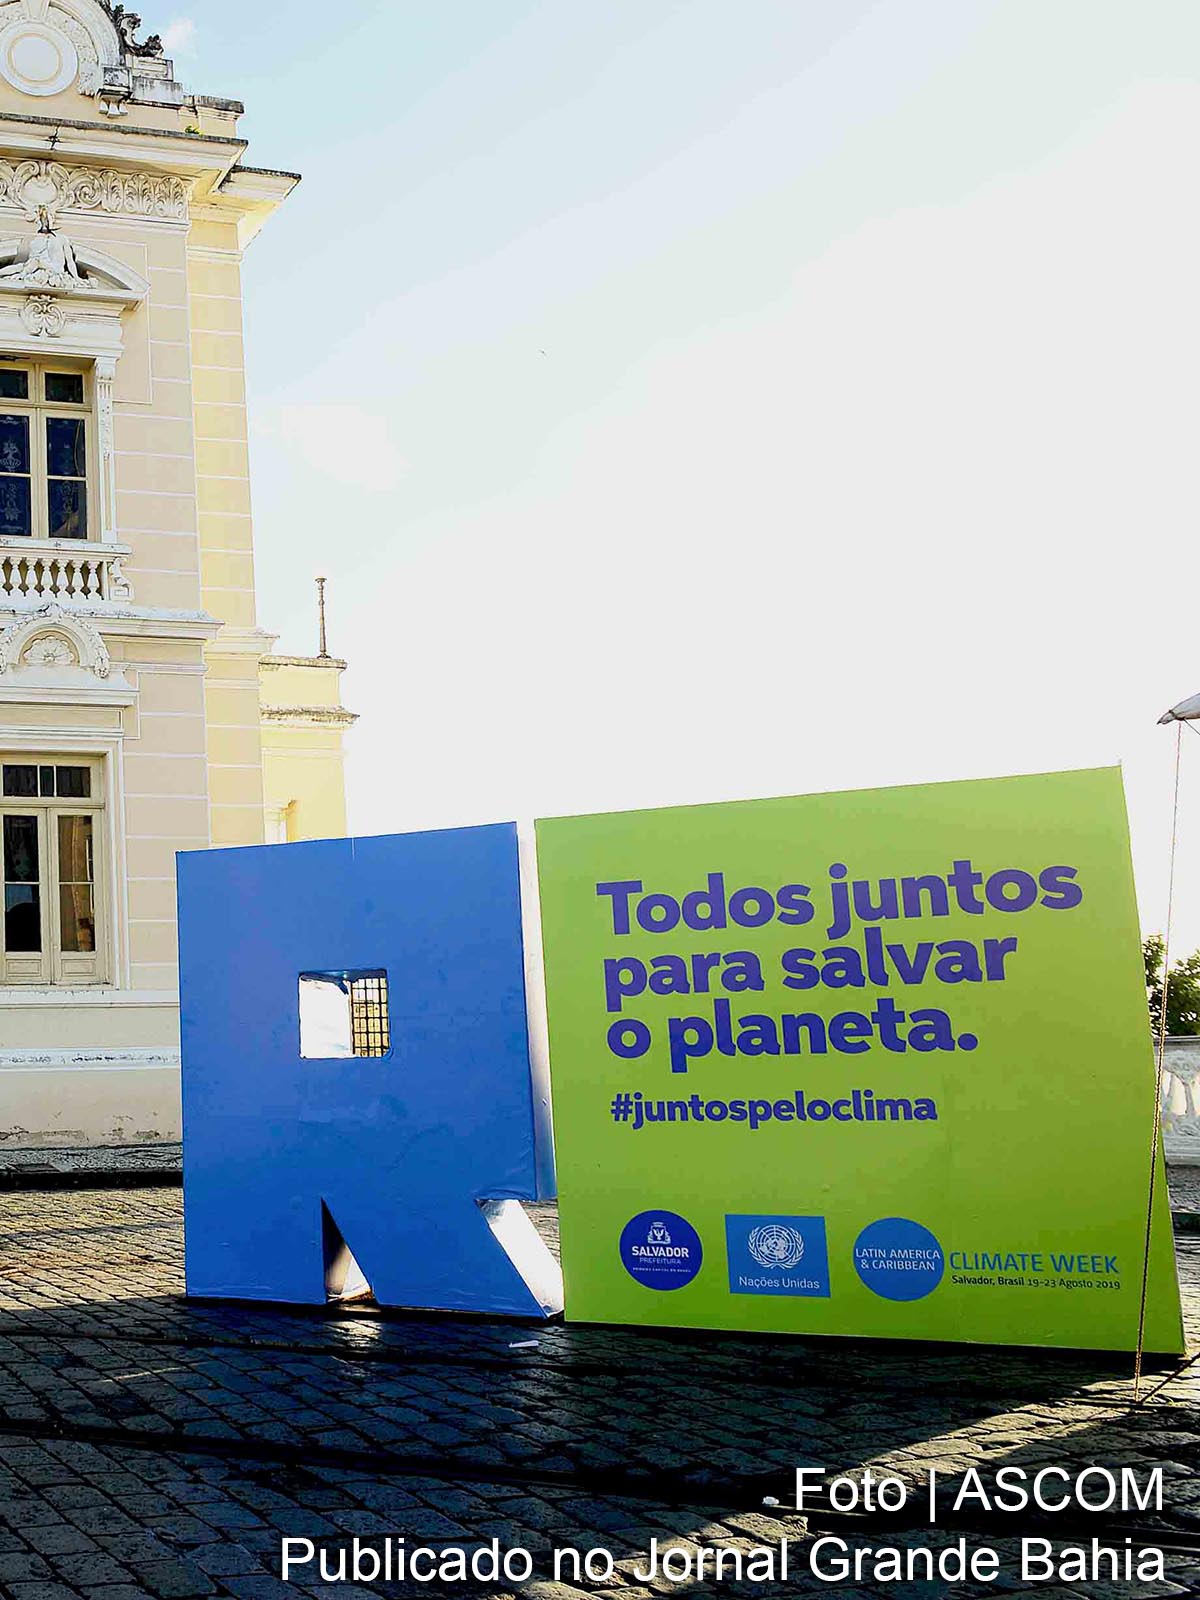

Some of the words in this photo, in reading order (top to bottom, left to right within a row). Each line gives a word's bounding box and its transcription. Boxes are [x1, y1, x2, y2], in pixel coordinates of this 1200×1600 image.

[596, 873, 815, 935] Todos
[826, 860, 1083, 940] juntos
[603, 950, 765, 1012] para
[781, 926, 1018, 990] salvar
[606, 1018, 651, 1059] o
[668, 997, 978, 1074] planeta.
[610, 1089, 938, 1130] #juntospeloclima
[631, 1245, 690, 1258] SALVADOR
[855, 1248, 887, 1258] LATIN
[889, 1249, 941, 1260] AMERICA
[639, 1257, 682, 1265] PREFEITURA
[860, 1258, 870, 1269] &
[872, 1259, 936, 1271] CARIBBEAN
[949, 1252, 1044, 1273] CLIMATE
[1050, 1254, 1120, 1274] WEEK
[738, 1275, 780, 1288] Nações
[782, 1277, 820, 1289] Unidas
[951, 1275, 995, 1286] Salvador,
[997, 1276, 1025, 1286] Brasil
[1059, 1278, 1093, 1290] Agosto
[1095, 1280, 1121, 1290] 2019
